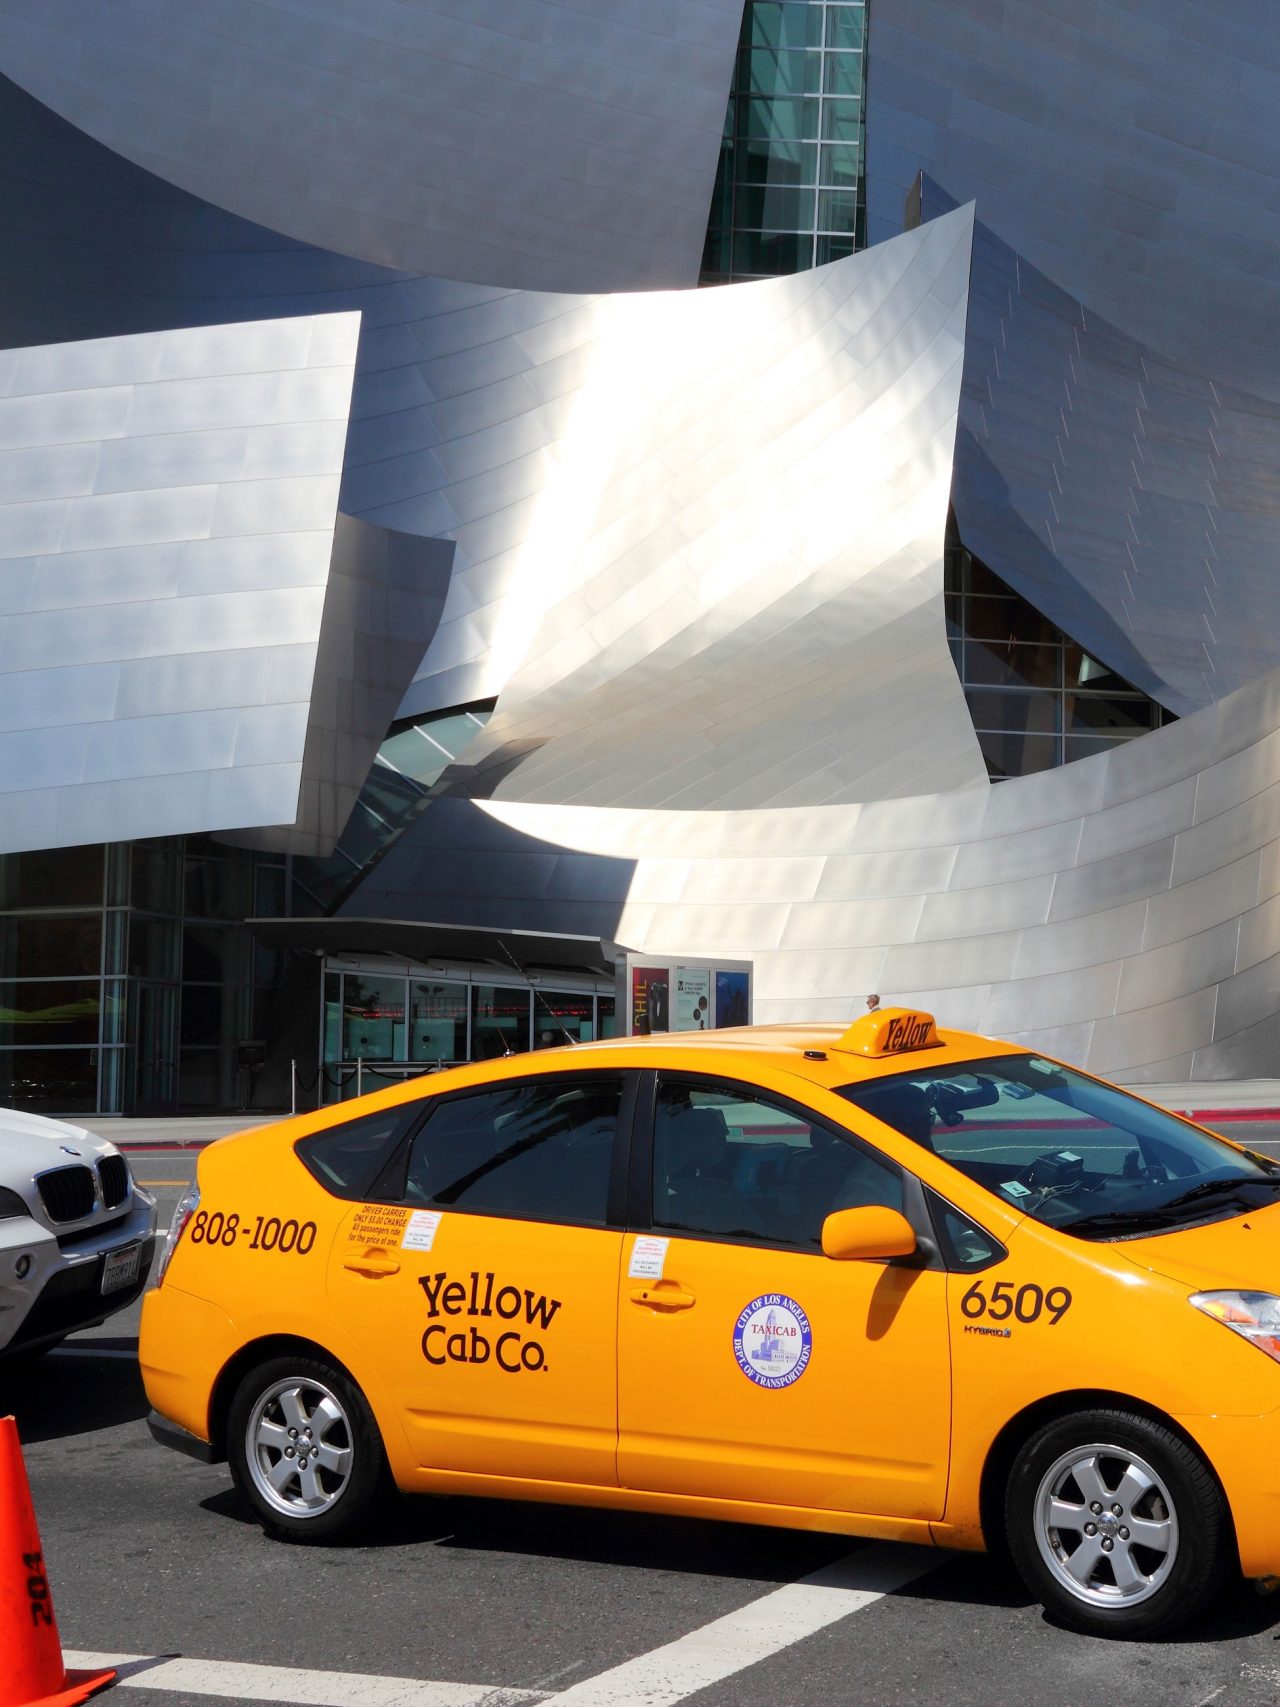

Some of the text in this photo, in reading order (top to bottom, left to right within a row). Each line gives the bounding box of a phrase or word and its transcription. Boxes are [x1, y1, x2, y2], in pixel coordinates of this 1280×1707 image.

[882, 1015, 933, 1051] Yellow
[191, 1210, 317, 1255] 808-1000
[354, 1214, 368, 1223] ONLY
[383, 1217, 407, 1227] CHANGE
[360, 1225, 390, 1236] passengers
[383, 1207, 407, 1218] CARRIES
[418, 1272, 563, 1330] Yellow
[737, 1294, 810, 1334] CITY OF LOS ANGELES
[961, 1280, 1073, 1325] 6509
[421, 1324, 549, 1373] Cab Co.
[751, 1324, 797, 1337] TAXICAB
[734, 1338, 811, 1388] DEPT. OF TRANSPORTATION
